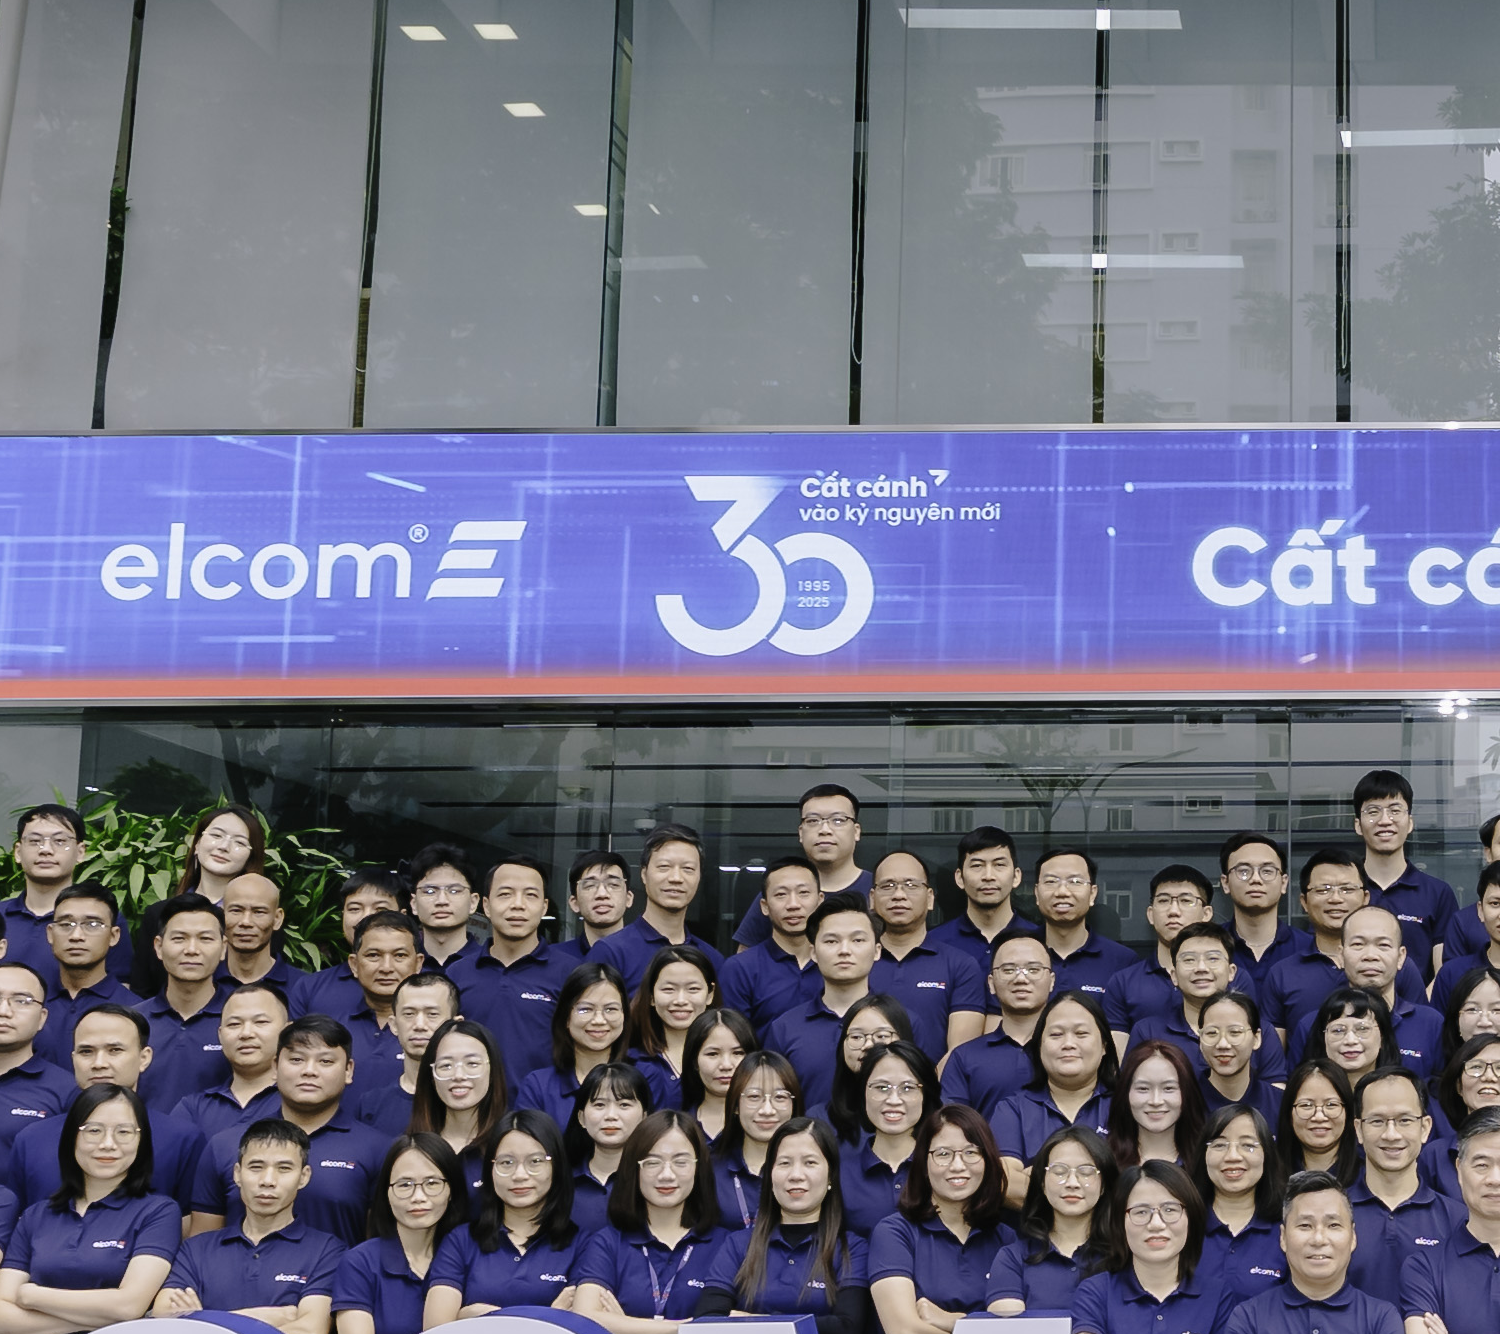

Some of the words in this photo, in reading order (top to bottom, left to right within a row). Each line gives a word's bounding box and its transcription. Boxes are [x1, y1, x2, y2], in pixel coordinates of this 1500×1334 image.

[800, 470, 851, 498] Cất
[856, 474, 928, 498] cánh
[799, 503, 840, 521] vào
[845, 502, 869, 526] kỷ
[874, 502, 954, 526] nguyên
[960, 502, 1001, 521] mới
[1192, 519, 1377, 607] Cất
[798, 580, 831, 593] 1995
[798, 596, 830, 609] 2025
[10, 1108, 38, 1117] elcom
[539, 1273, 567, 1282] elcom
[1249, 1266, 1275, 1276] elcom
[687, 1279, 705, 1288] elco
